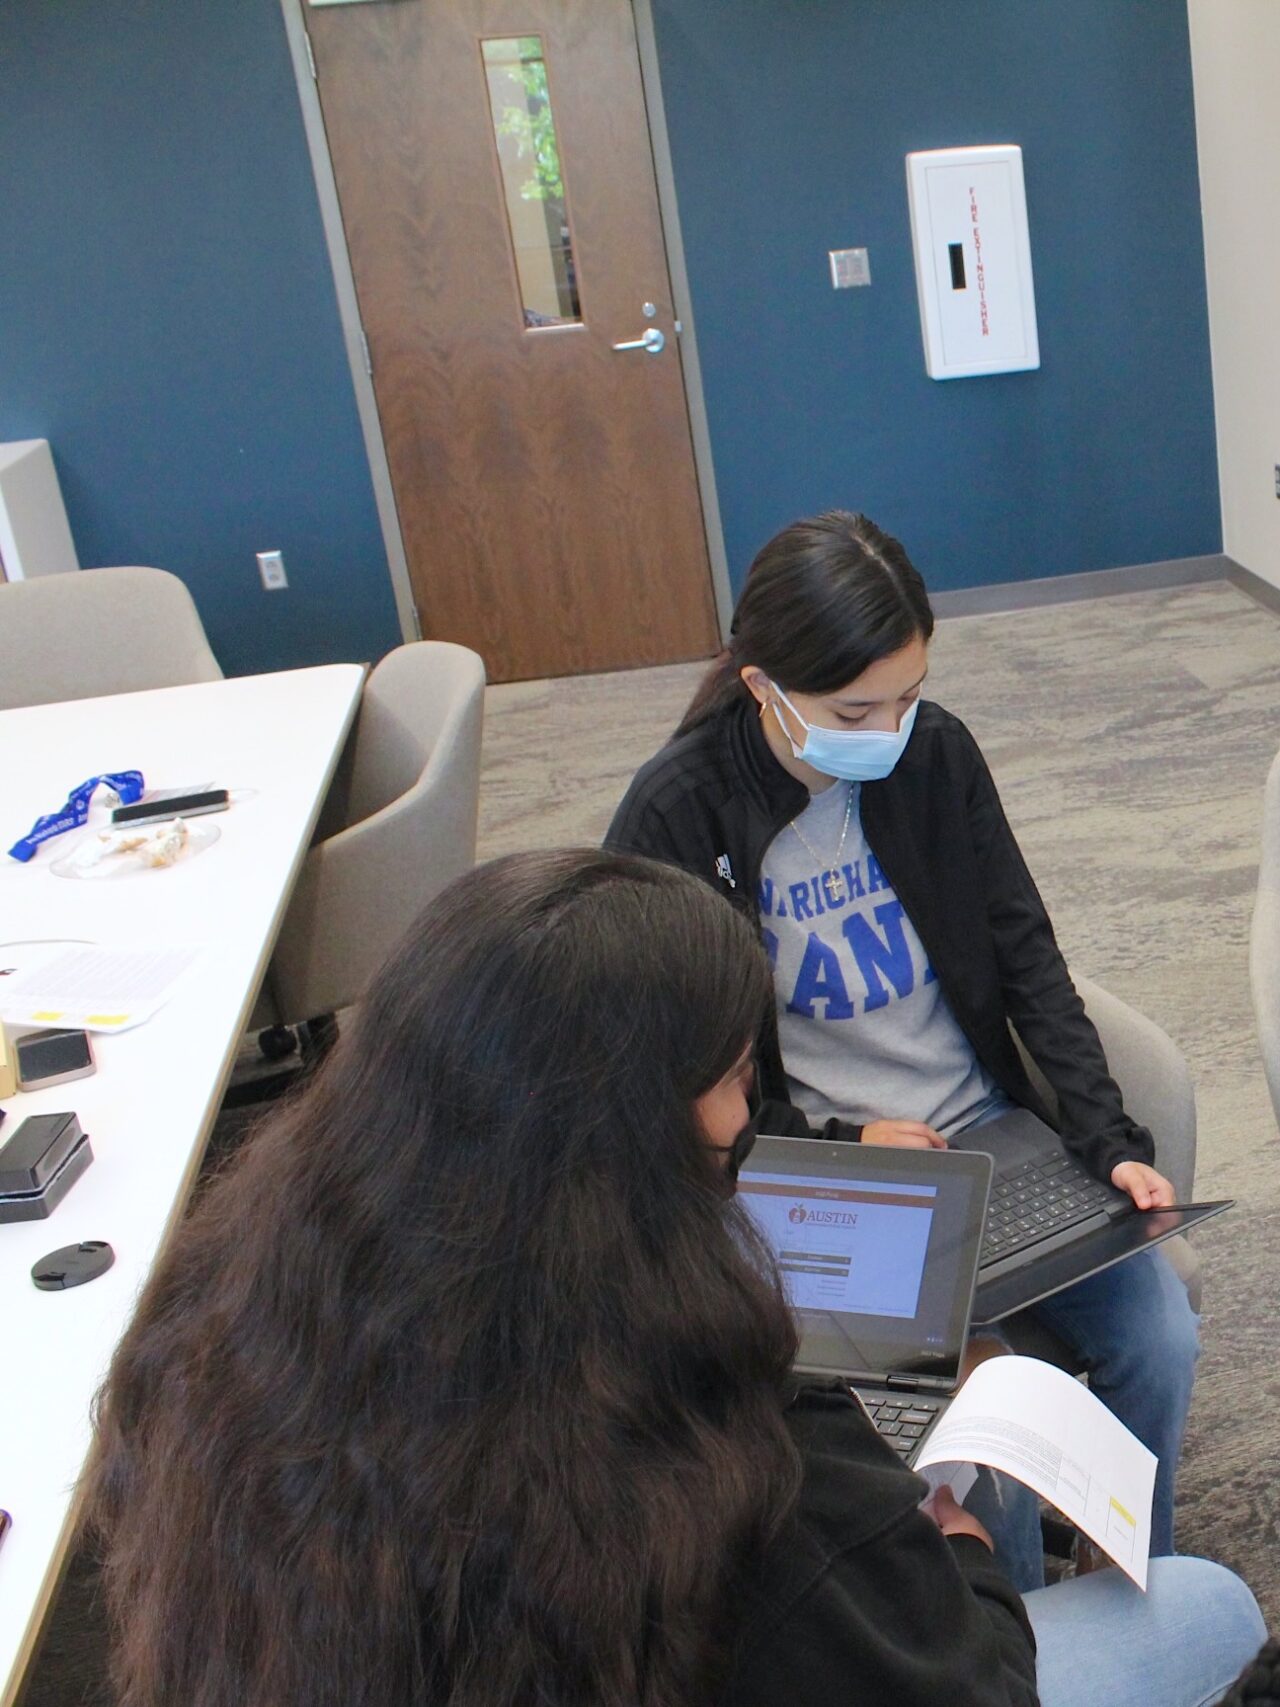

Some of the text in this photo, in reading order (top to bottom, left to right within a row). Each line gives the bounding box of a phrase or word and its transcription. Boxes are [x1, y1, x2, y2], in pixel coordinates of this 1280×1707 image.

[969, 187, 979, 223] FIRE
[973, 227, 989, 336] EXTINGUISHER
[807, 1210, 859, 1226] AUSTIN
